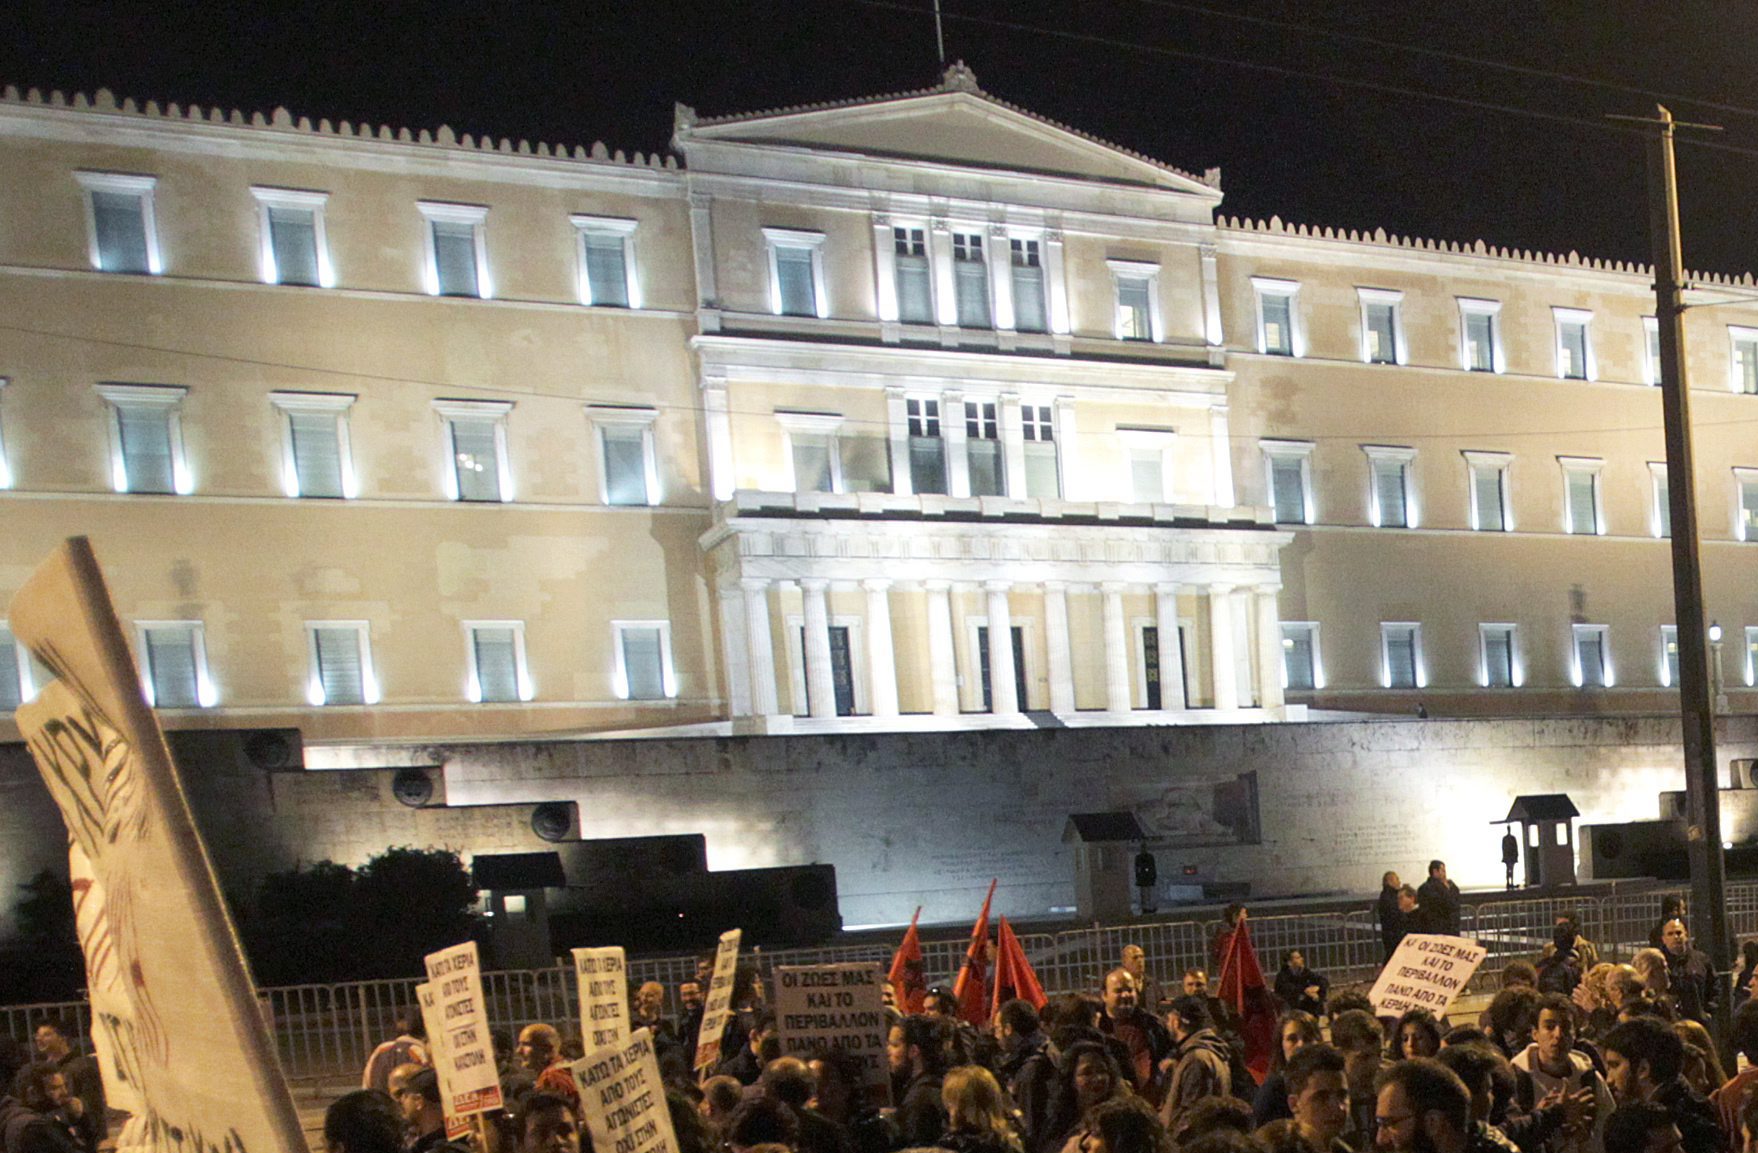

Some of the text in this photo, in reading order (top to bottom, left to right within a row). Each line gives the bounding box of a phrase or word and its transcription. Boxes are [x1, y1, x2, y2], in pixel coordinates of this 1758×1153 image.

[1421, 957, 1454, 971] ΚΑΙ ΤΟ
[1455, 948, 1480, 963] ΜΑΣ
[782, 970, 875, 988] ΟΙ ΖΩΕΣ ΜΑΣ
[1397, 966, 1461, 990] ΠΕΡΙΒΑΛΛΟΝ
[806, 991, 854, 1008] ΚΑΙ ΤΟ
[1412, 988, 1436, 1004] ΑΠΟ
[1434, 995, 1449, 1008] ΤΑ
[784, 1011, 880, 1030] ΠΕΡΙΒΑΛΛΟΝ
[831, 1034, 862, 1051] ΑΠΟ
[863, 1033, 883, 1049] ΤΑ
[578, 1042, 652, 1090] ΚΑΤΩ ΤΑ ΧΕΡΙΑ
[599, 1067, 648, 1107] ΑΠΟ ΤΟΥΣ
[604, 1089, 655, 1132] ΑΓΩΝΙΣΤΕΣ
[635, 1118, 659, 1147] ΣΤΗΝ
